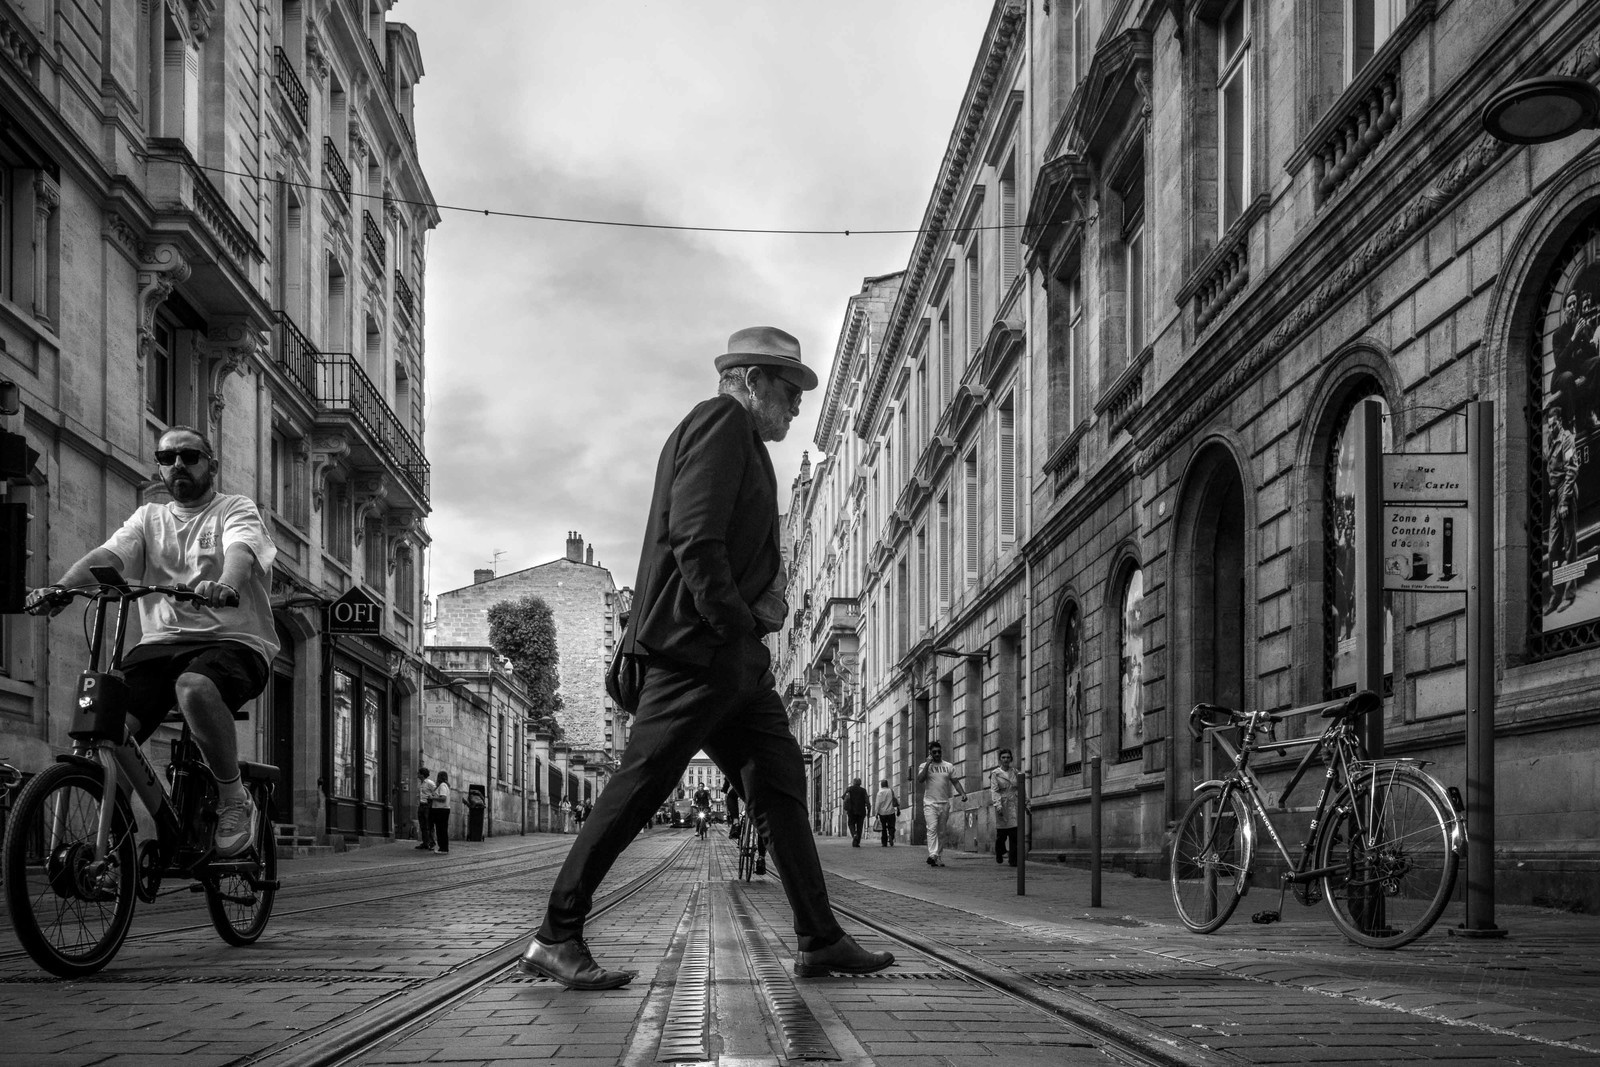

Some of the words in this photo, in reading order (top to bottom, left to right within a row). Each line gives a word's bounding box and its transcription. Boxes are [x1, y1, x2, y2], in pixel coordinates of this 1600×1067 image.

[1425, 481, 1460, 489] Carles
[1392, 513, 1417, 523] Zone
[1424, 514, 1430, 523] à
[1391, 526, 1437, 536] Contrôle
[335, 602, 375, 623] OFI
[1257, 806, 1278, 840] PEUGEOT
